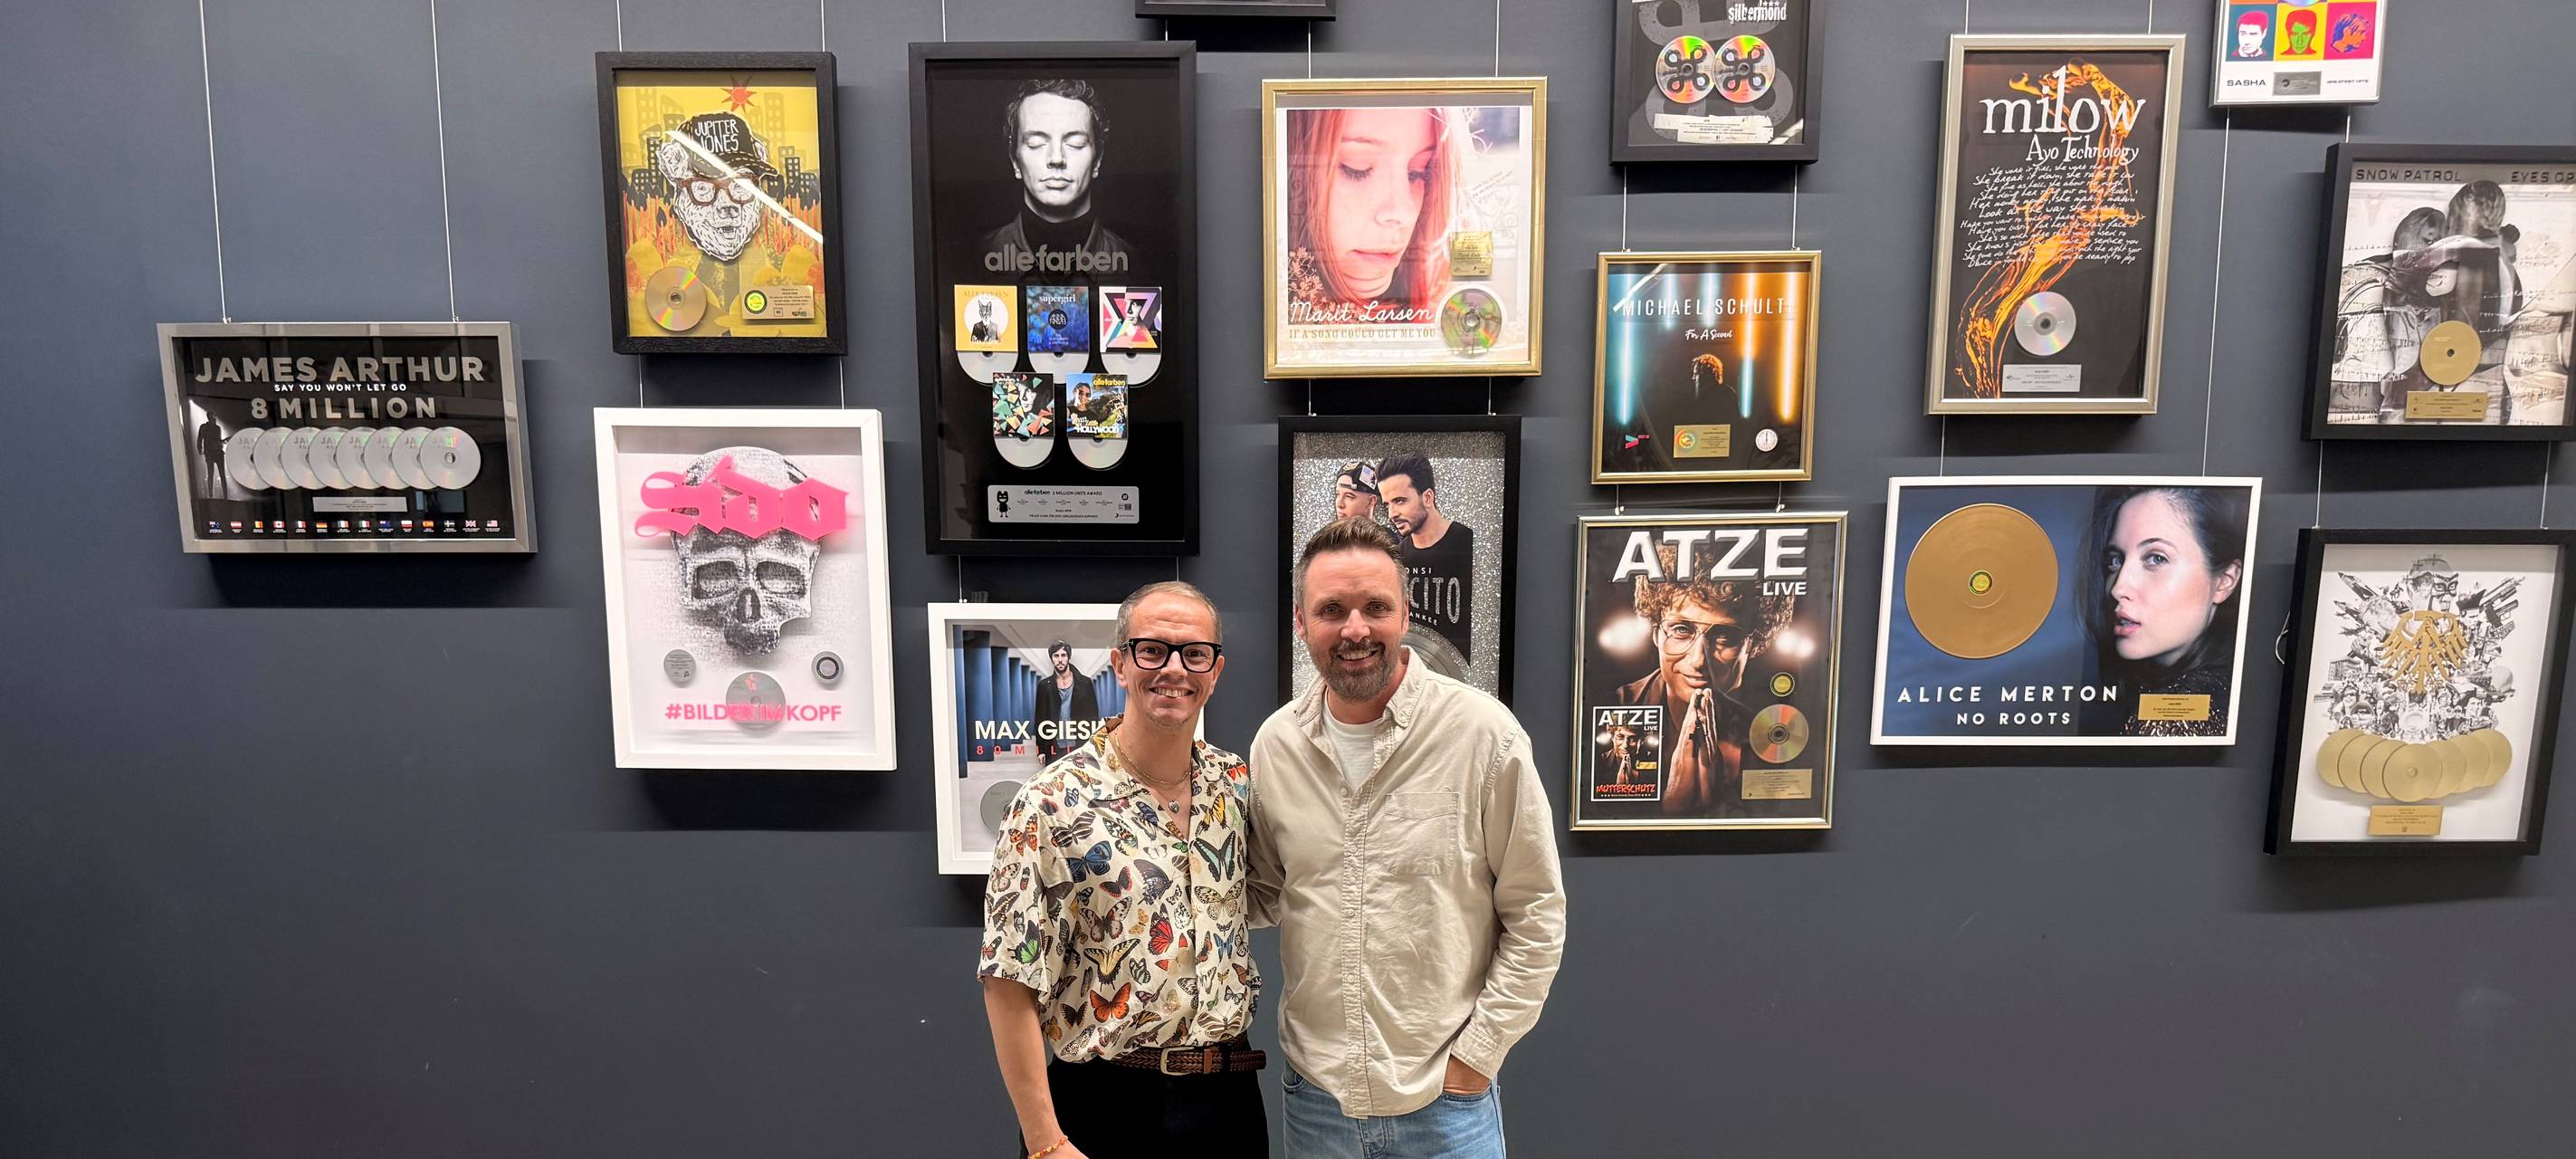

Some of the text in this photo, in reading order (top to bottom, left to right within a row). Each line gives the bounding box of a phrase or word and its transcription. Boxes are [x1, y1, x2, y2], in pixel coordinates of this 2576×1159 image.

[1980, 65, 2146, 134] milow
[695, 119, 739, 137] JUPITER
[2026, 134, 2139, 166] Ayo Technology
[2355, 169, 2461, 182] SNOW PATROL
[2512, 171, 2549, 182] EYES
[1979, 207, 2003, 218] Look
[1039, 293, 1076, 304] supergirl
[1290, 300, 1435, 322] Marit Larsen
[1623, 298, 1794, 316] MICHAEL SCHULT
[1290, 329, 1436, 339] IF A SONG COULD GET ME YOU
[1685, 330, 1732, 340] For A Second
[196, 356, 485, 383] JAMES ARTHUR
[274, 384, 406, 392] SAY YOU WON'T LET GO
[252, 398, 436, 419] 8 MILLION
[1077, 426, 1119, 434] HOLLYWOOD
[1612, 528, 1808, 582] ATZE
[1762, 581, 1807, 596] LIVE
[1898, 685, 2117, 703] ALICE MERTON
[787, 704, 842, 722] KOPF
[1598, 710, 1658, 725] ATZE
[1957, 713, 2071, 725] NO ROOTS
[975, 720, 1102, 741] MAX GIESI
[1596, 783, 1656, 793] MUTTERSCHUTZ
